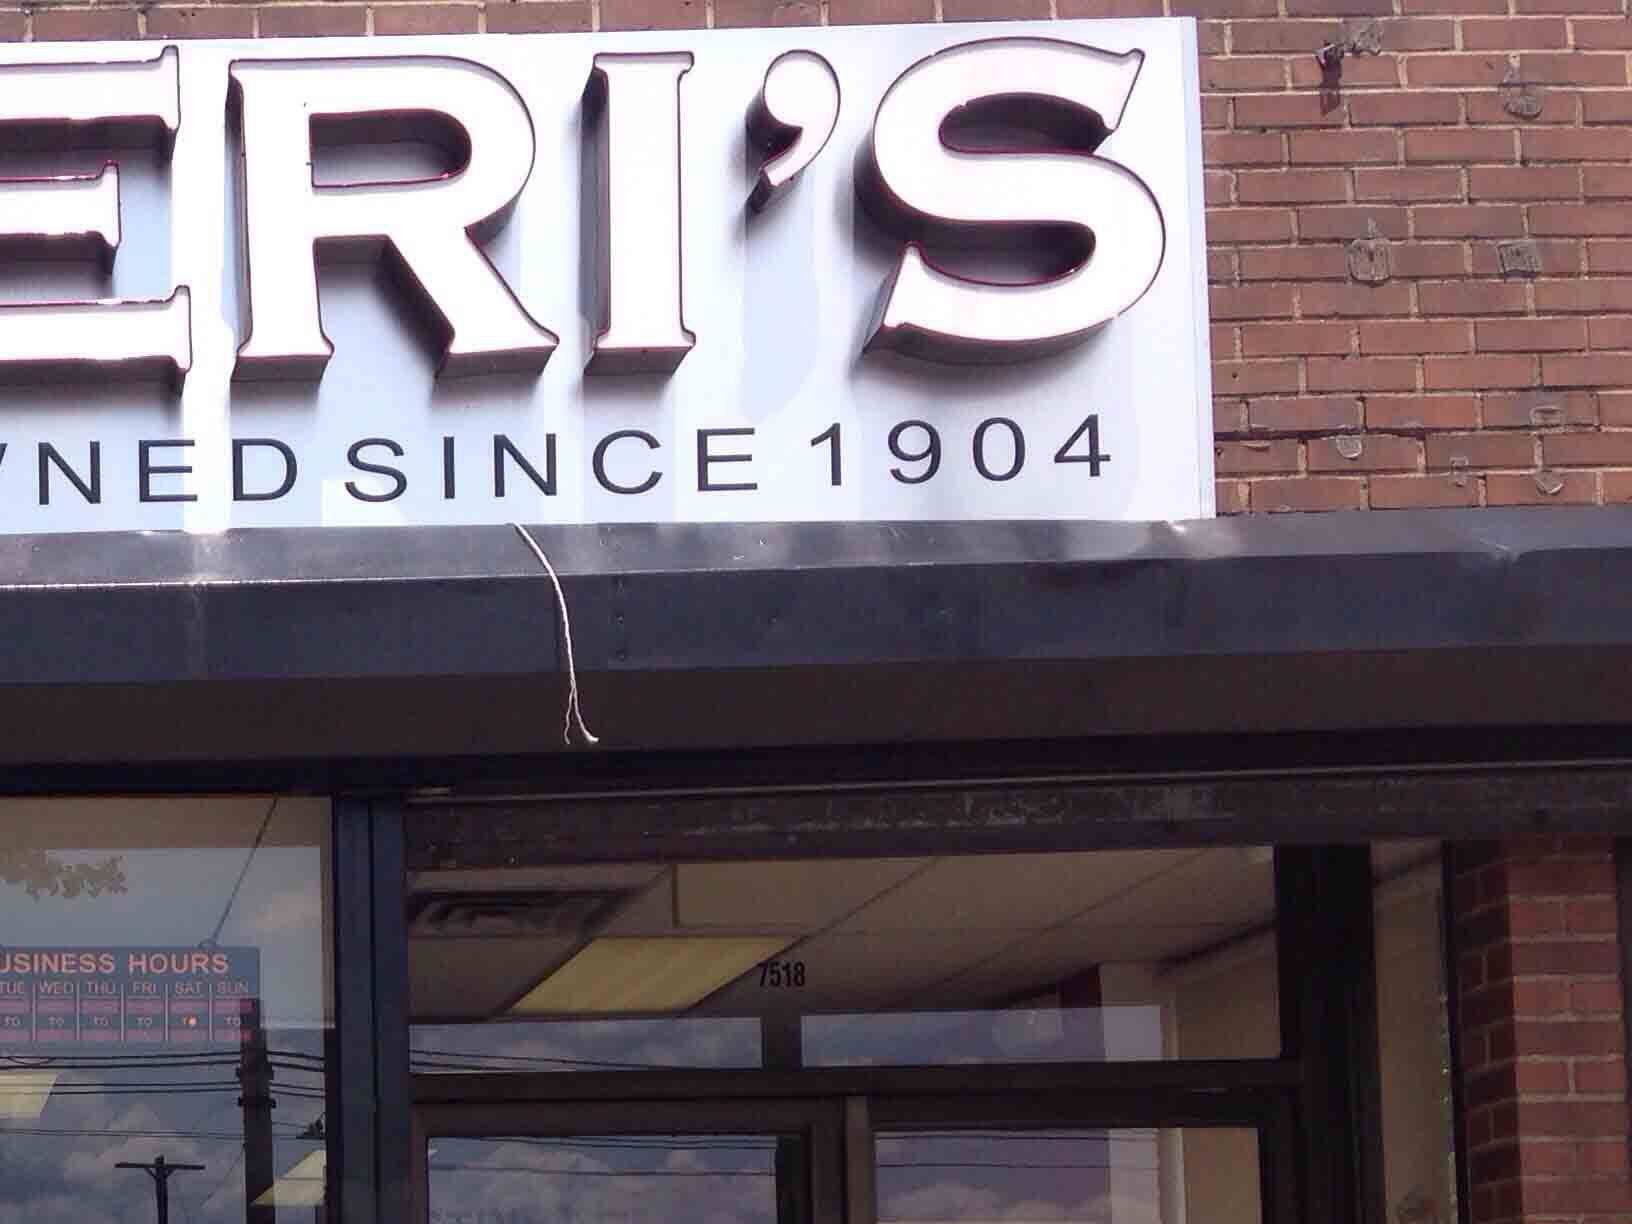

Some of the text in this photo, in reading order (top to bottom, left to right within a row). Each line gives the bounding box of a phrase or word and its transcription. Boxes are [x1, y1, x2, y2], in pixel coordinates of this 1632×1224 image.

[344, 427, 759, 501] SINCE
[810, 414, 1112, 486] 1904
[127, 953, 229, 974] HOURS
[759, 961, 806, 988] 7518
